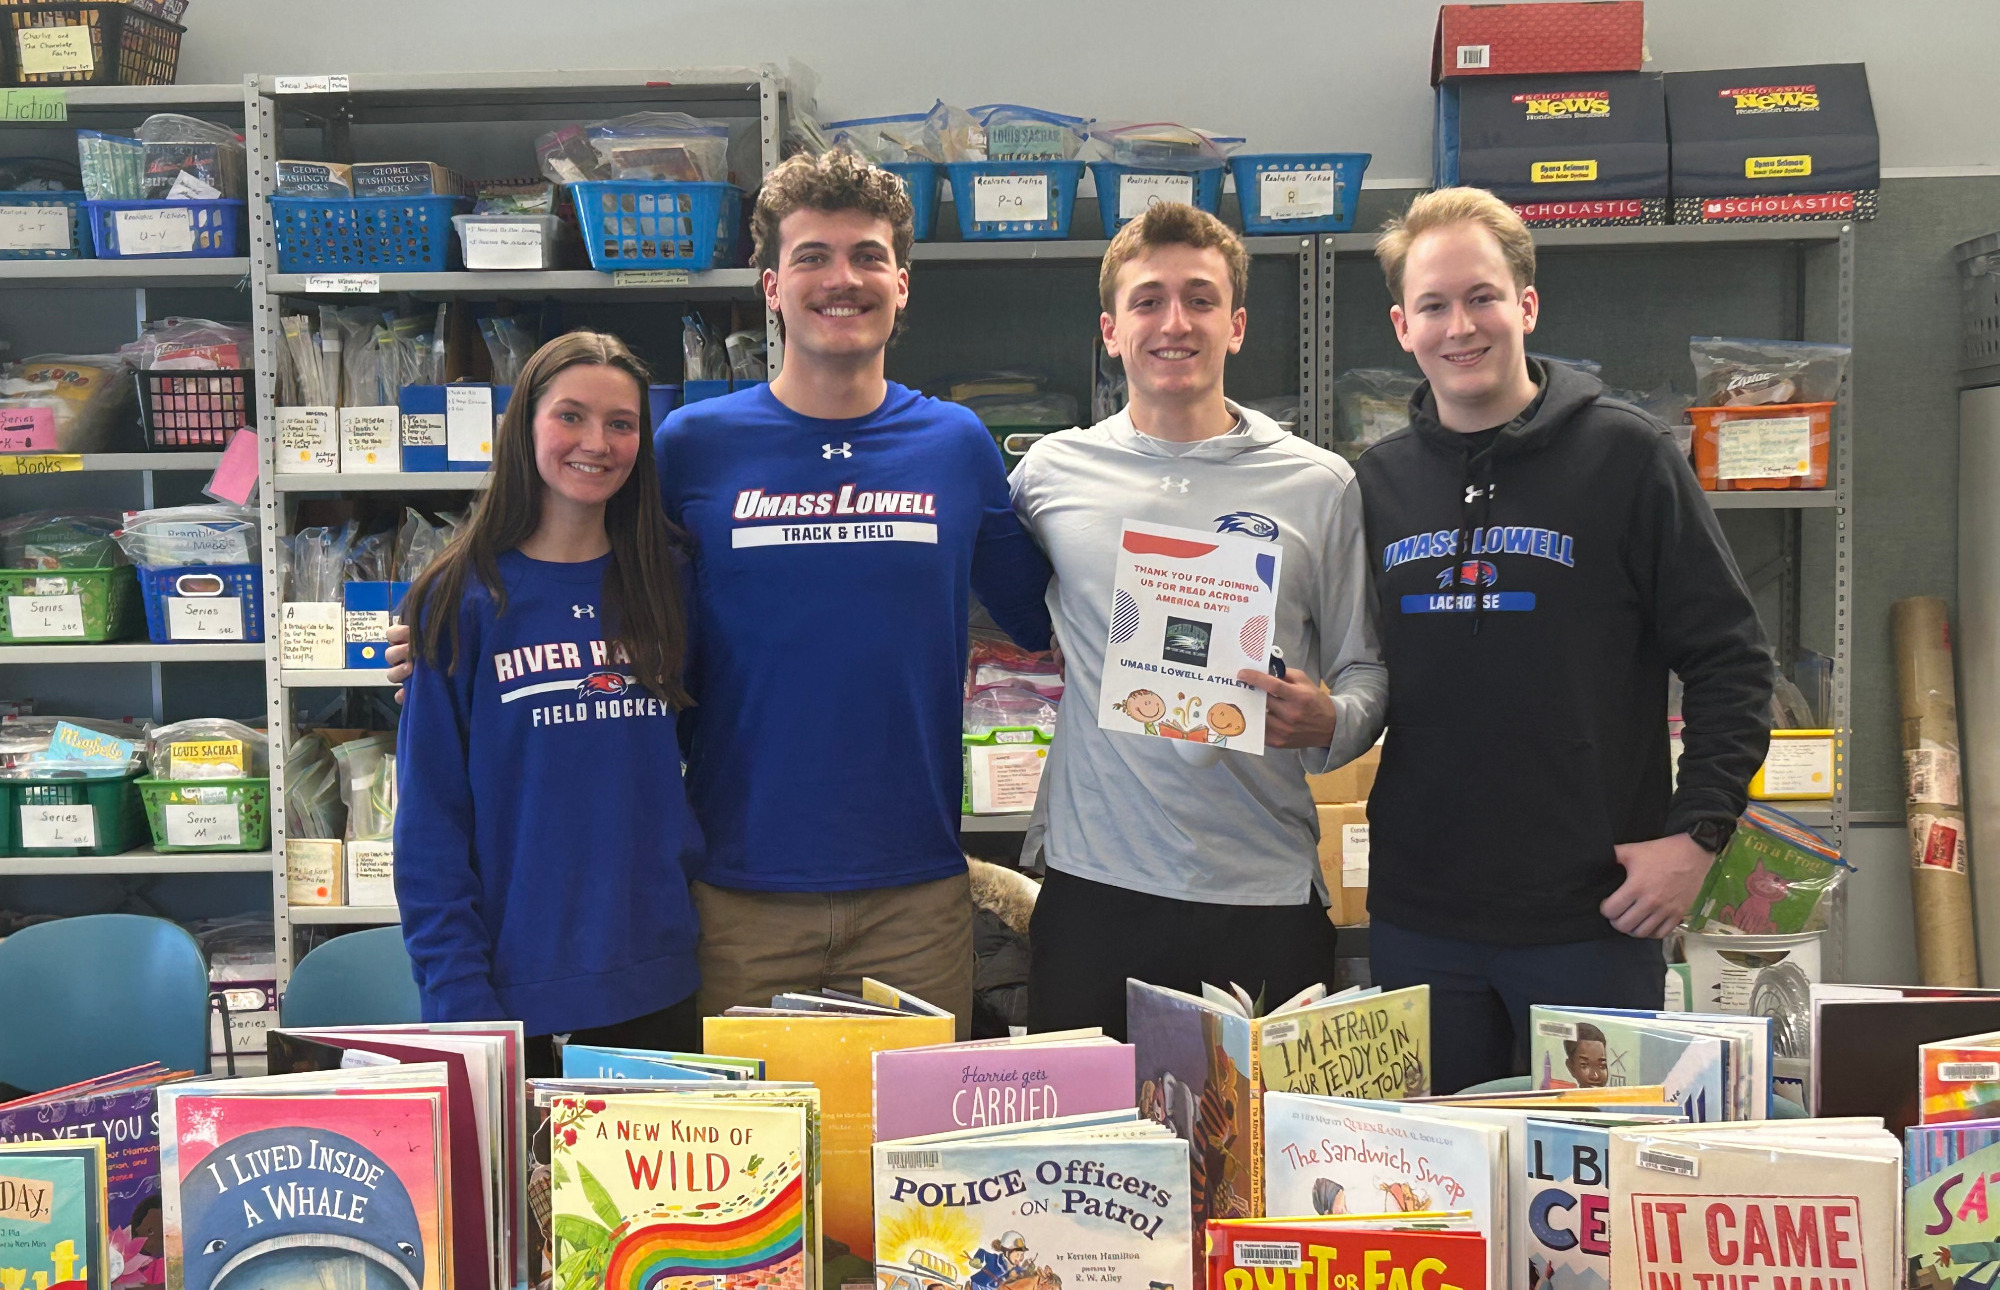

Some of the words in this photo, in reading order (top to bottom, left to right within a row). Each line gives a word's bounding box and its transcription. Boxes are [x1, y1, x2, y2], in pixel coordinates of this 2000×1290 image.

[5, 90, 65, 119] Fiction
[278, 174, 330, 183] WASHINGTO
[292, 166, 328, 174] GEORGE
[373, 167, 409, 176] GEORGE
[297, 183, 329, 192] SOCKS
[377, 185, 410, 193] SOCKS
[1513, 201, 1639, 217] SCHOLASTIC
[1725, 196, 1851, 213] SCHOLASTIC
[15, 455, 62, 476] Books
[732, 488, 834, 520] UMASS
[833, 483, 937, 518] LOWELL
[782, 526, 832, 541] TRACK
[838, 525, 849, 540] &
[854, 524, 894, 540] FIELD
[1471, 526, 1576, 568] LOWELL
[1134, 564, 1169, 578] THANK
[1171, 571, 1193, 583] YOU
[1195, 575, 1215, 586] FOR
[1218, 579, 1260, 593] JOINING
[1140, 578, 1154, 588] US
[1156, 581, 1176, 592] FOR
[1179, 585, 1206, 597] READ
[1208, 590, 1250, 604] ACROSS
[30, 602, 64, 613] Series
[185, 603, 219, 616] Series
[1155, 593, 1200, 610] AMERICA
[1429, 593, 1500, 611] LACROSE
[44, 617, 51, 627] L
[197, 620, 206, 631] L
[494, 642, 582, 683] RIVER
[1120, 658, 1158, 673] UMASS
[1160, 666, 1204, 682] LOWELL
[532, 701, 588, 728] FIELD
[595, 698, 668, 720] HOCKEY
[172, 745, 200, 757] LOUIS
[202, 743, 240, 756] SACHAR
[40, 811, 79, 823] Series
[187, 811, 217, 824] Series
[54, 828, 64, 840] L
[229, 1017, 267, 1029] Series
[238, 1036, 251, 1047] N
[1275, 1029, 1316, 1079] IM
[1320, 1009, 1389, 1055] AFRAID
[1318, 1043, 1373, 1096] TEDDY
[1376, 1042, 1388, 1066] IS
[1390, 1020, 1410, 1056] IN
[962, 1065, 1018, 1084] Harriet
[1022, 1068, 1048, 1088] gets
[952, 1084, 1058, 1127] CARRIED
[102, 1115, 142, 1145] YOU
[596, 1121, 609, 1141] A
[617, 1119, 660, 1142] NEW
[672, 1119, 720, 1144] KIND
[730, 1127, 754, 1146] OF
[1343, 1118, 1375, 1133] QUEEN
[206, 1163, 229, 1194] I
[225, 1144, 303, 1186] LIVED
[308, 1139, 385, 1190] INSIDE
[625, 1148, 731, 1193] WILD
[1282, 1142, 1320, 1170] The
[1321, 1138, 1411, 1174] Sandwich
[1416, 1156, 1466, 1207] Swap
[889, 1168, 1028, 1208] POLICE
[1035, 1159, 1173, 1209] Officers
[243, 1199, 264, 1228] A
[261, 1182, 369, 1224] WHALE
[1020, 1199, 1049, 1217] ON
[1061, 1189, 1164, 1241] Patrol
[1641, 1202, 1687, 1263] IT
[1705, 1202, 1858, 1269] CAME
[1100, 1252, 1140, 1261] Hamilton
[1086, 1273, 1098, 1282] W.
[1333, 1273, 1360, 1290] OR
